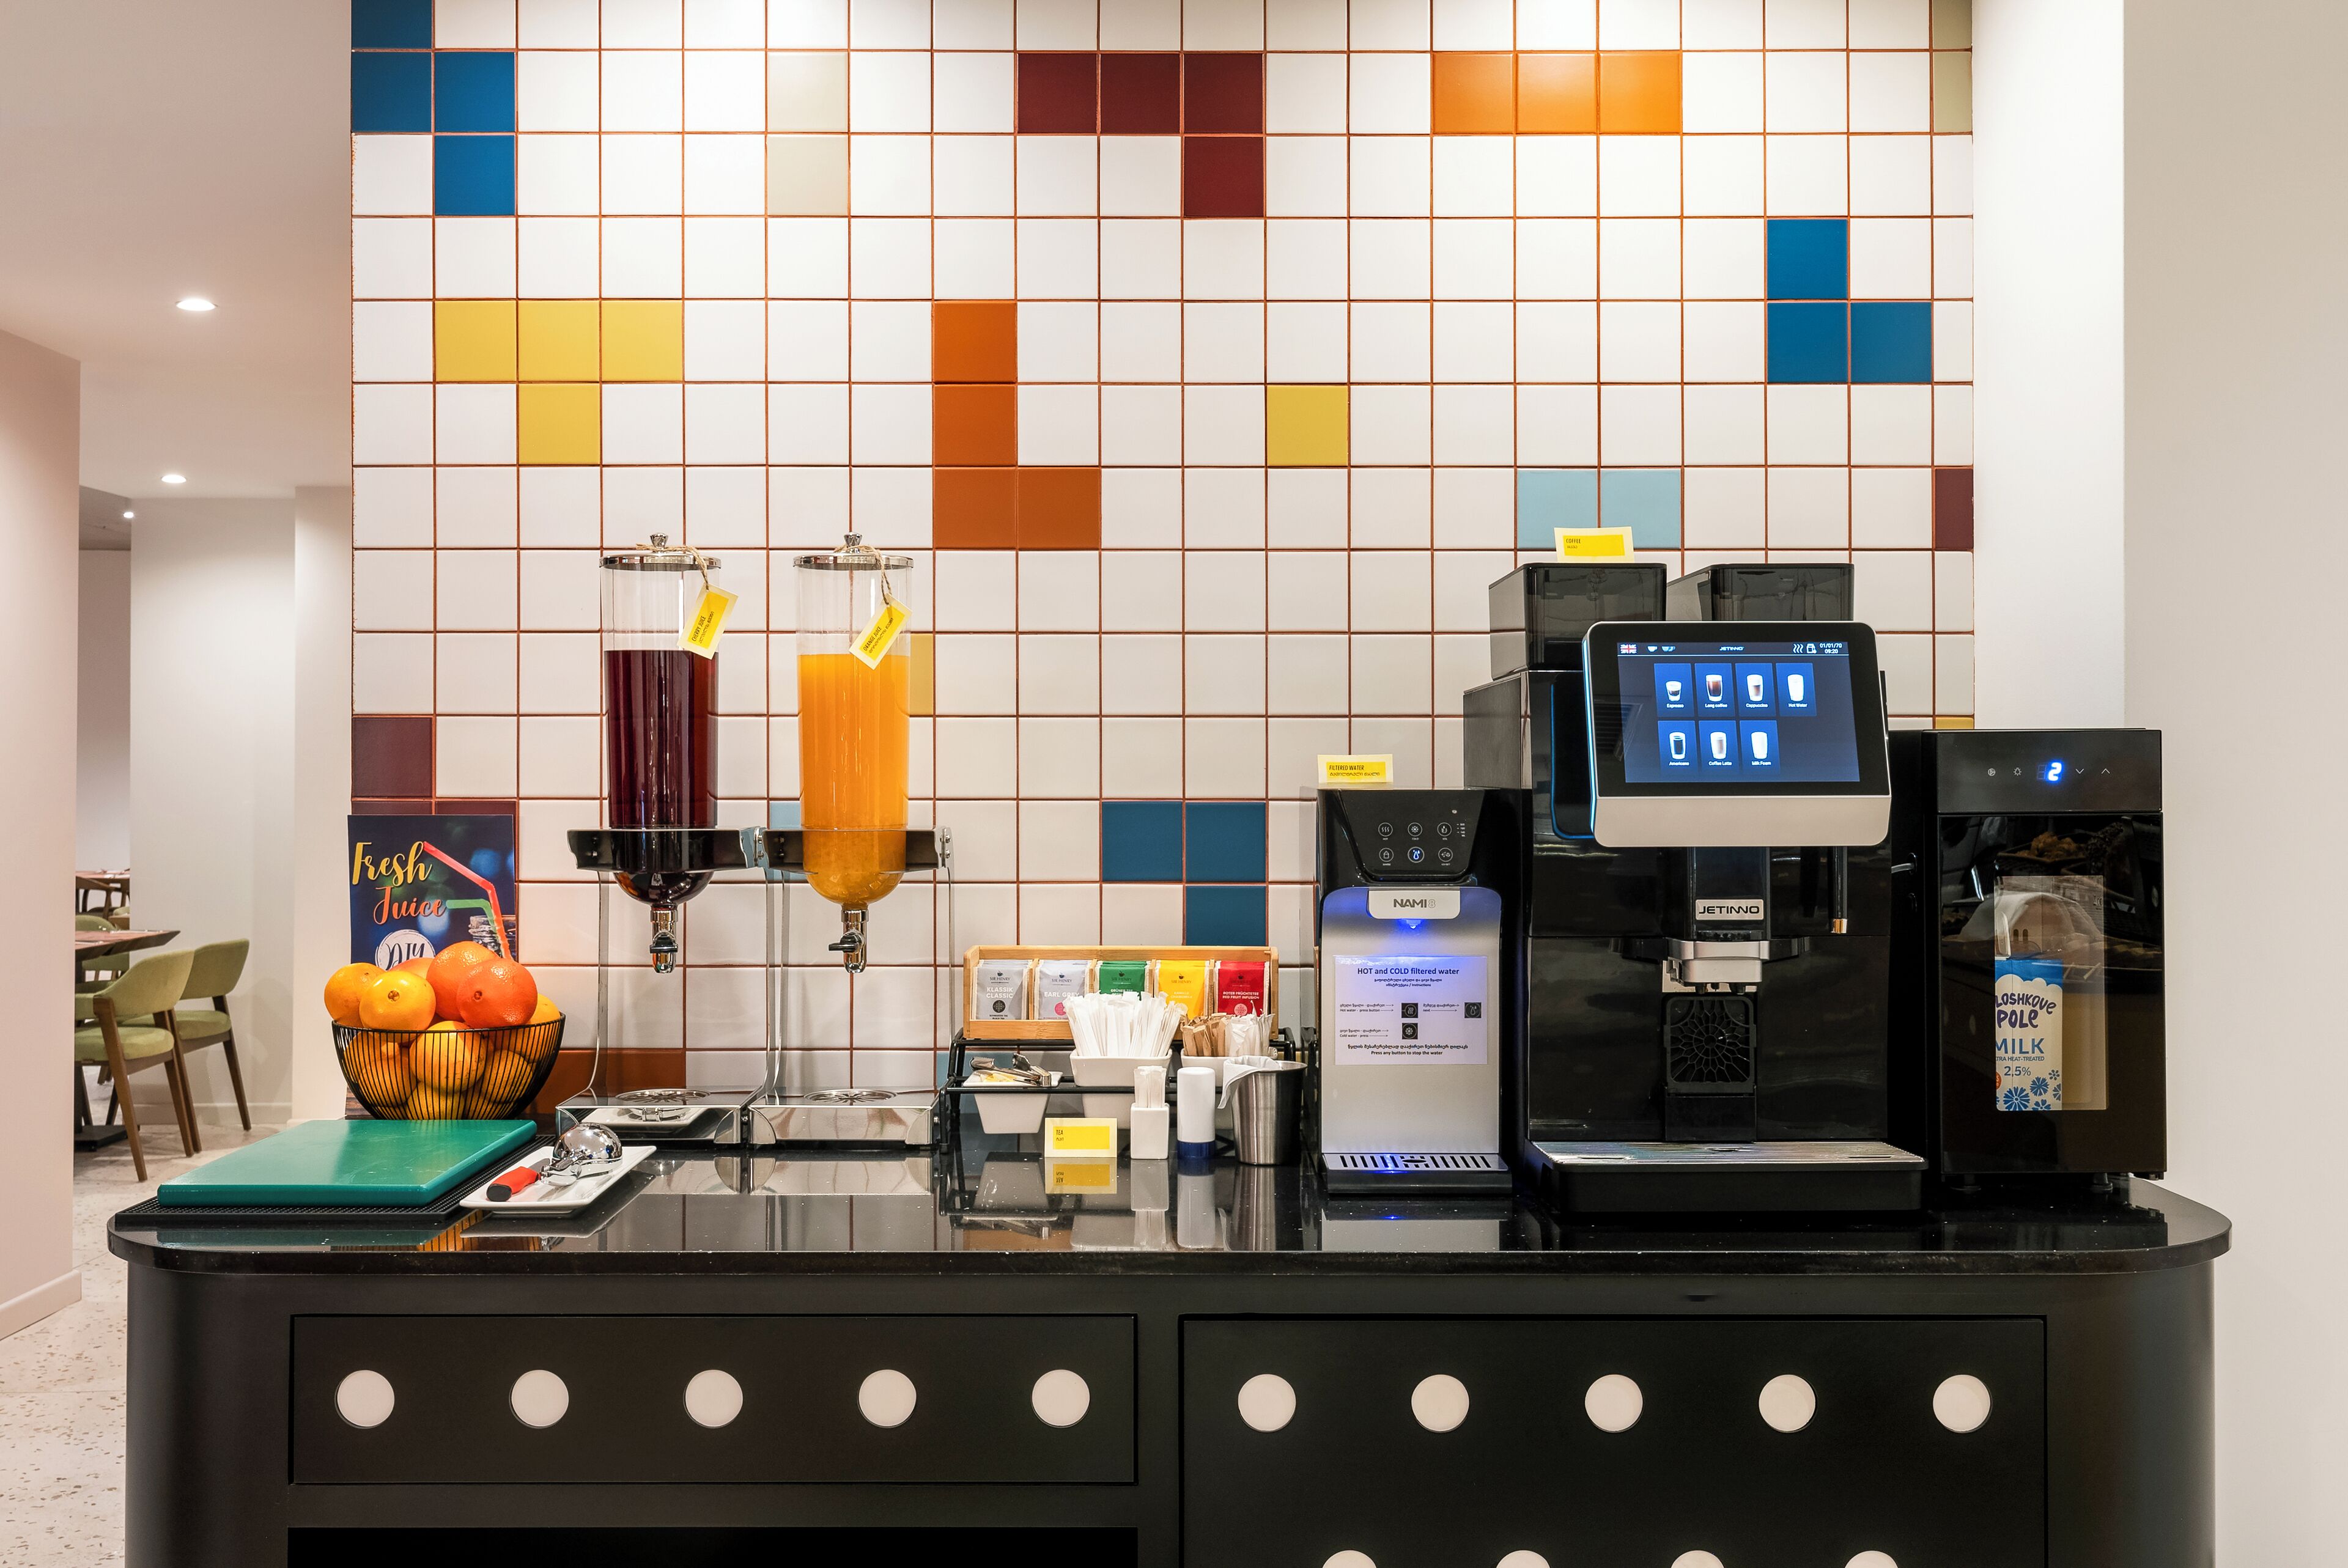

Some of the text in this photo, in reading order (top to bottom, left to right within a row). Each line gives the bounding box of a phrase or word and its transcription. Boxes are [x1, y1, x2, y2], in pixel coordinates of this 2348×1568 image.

[692, 626, 701, 641] CHERRY
[863, 626, 882, 651] ORANGE JUICE
[2048, 762, 2062, 781] 2
[352, 841, 432, 886] Fresh
[374, 885, 447, 925] Juice
[1996, 1039, 2045, 1055] MILK
[2004, 1066, 2031, 1077] 2,5%
